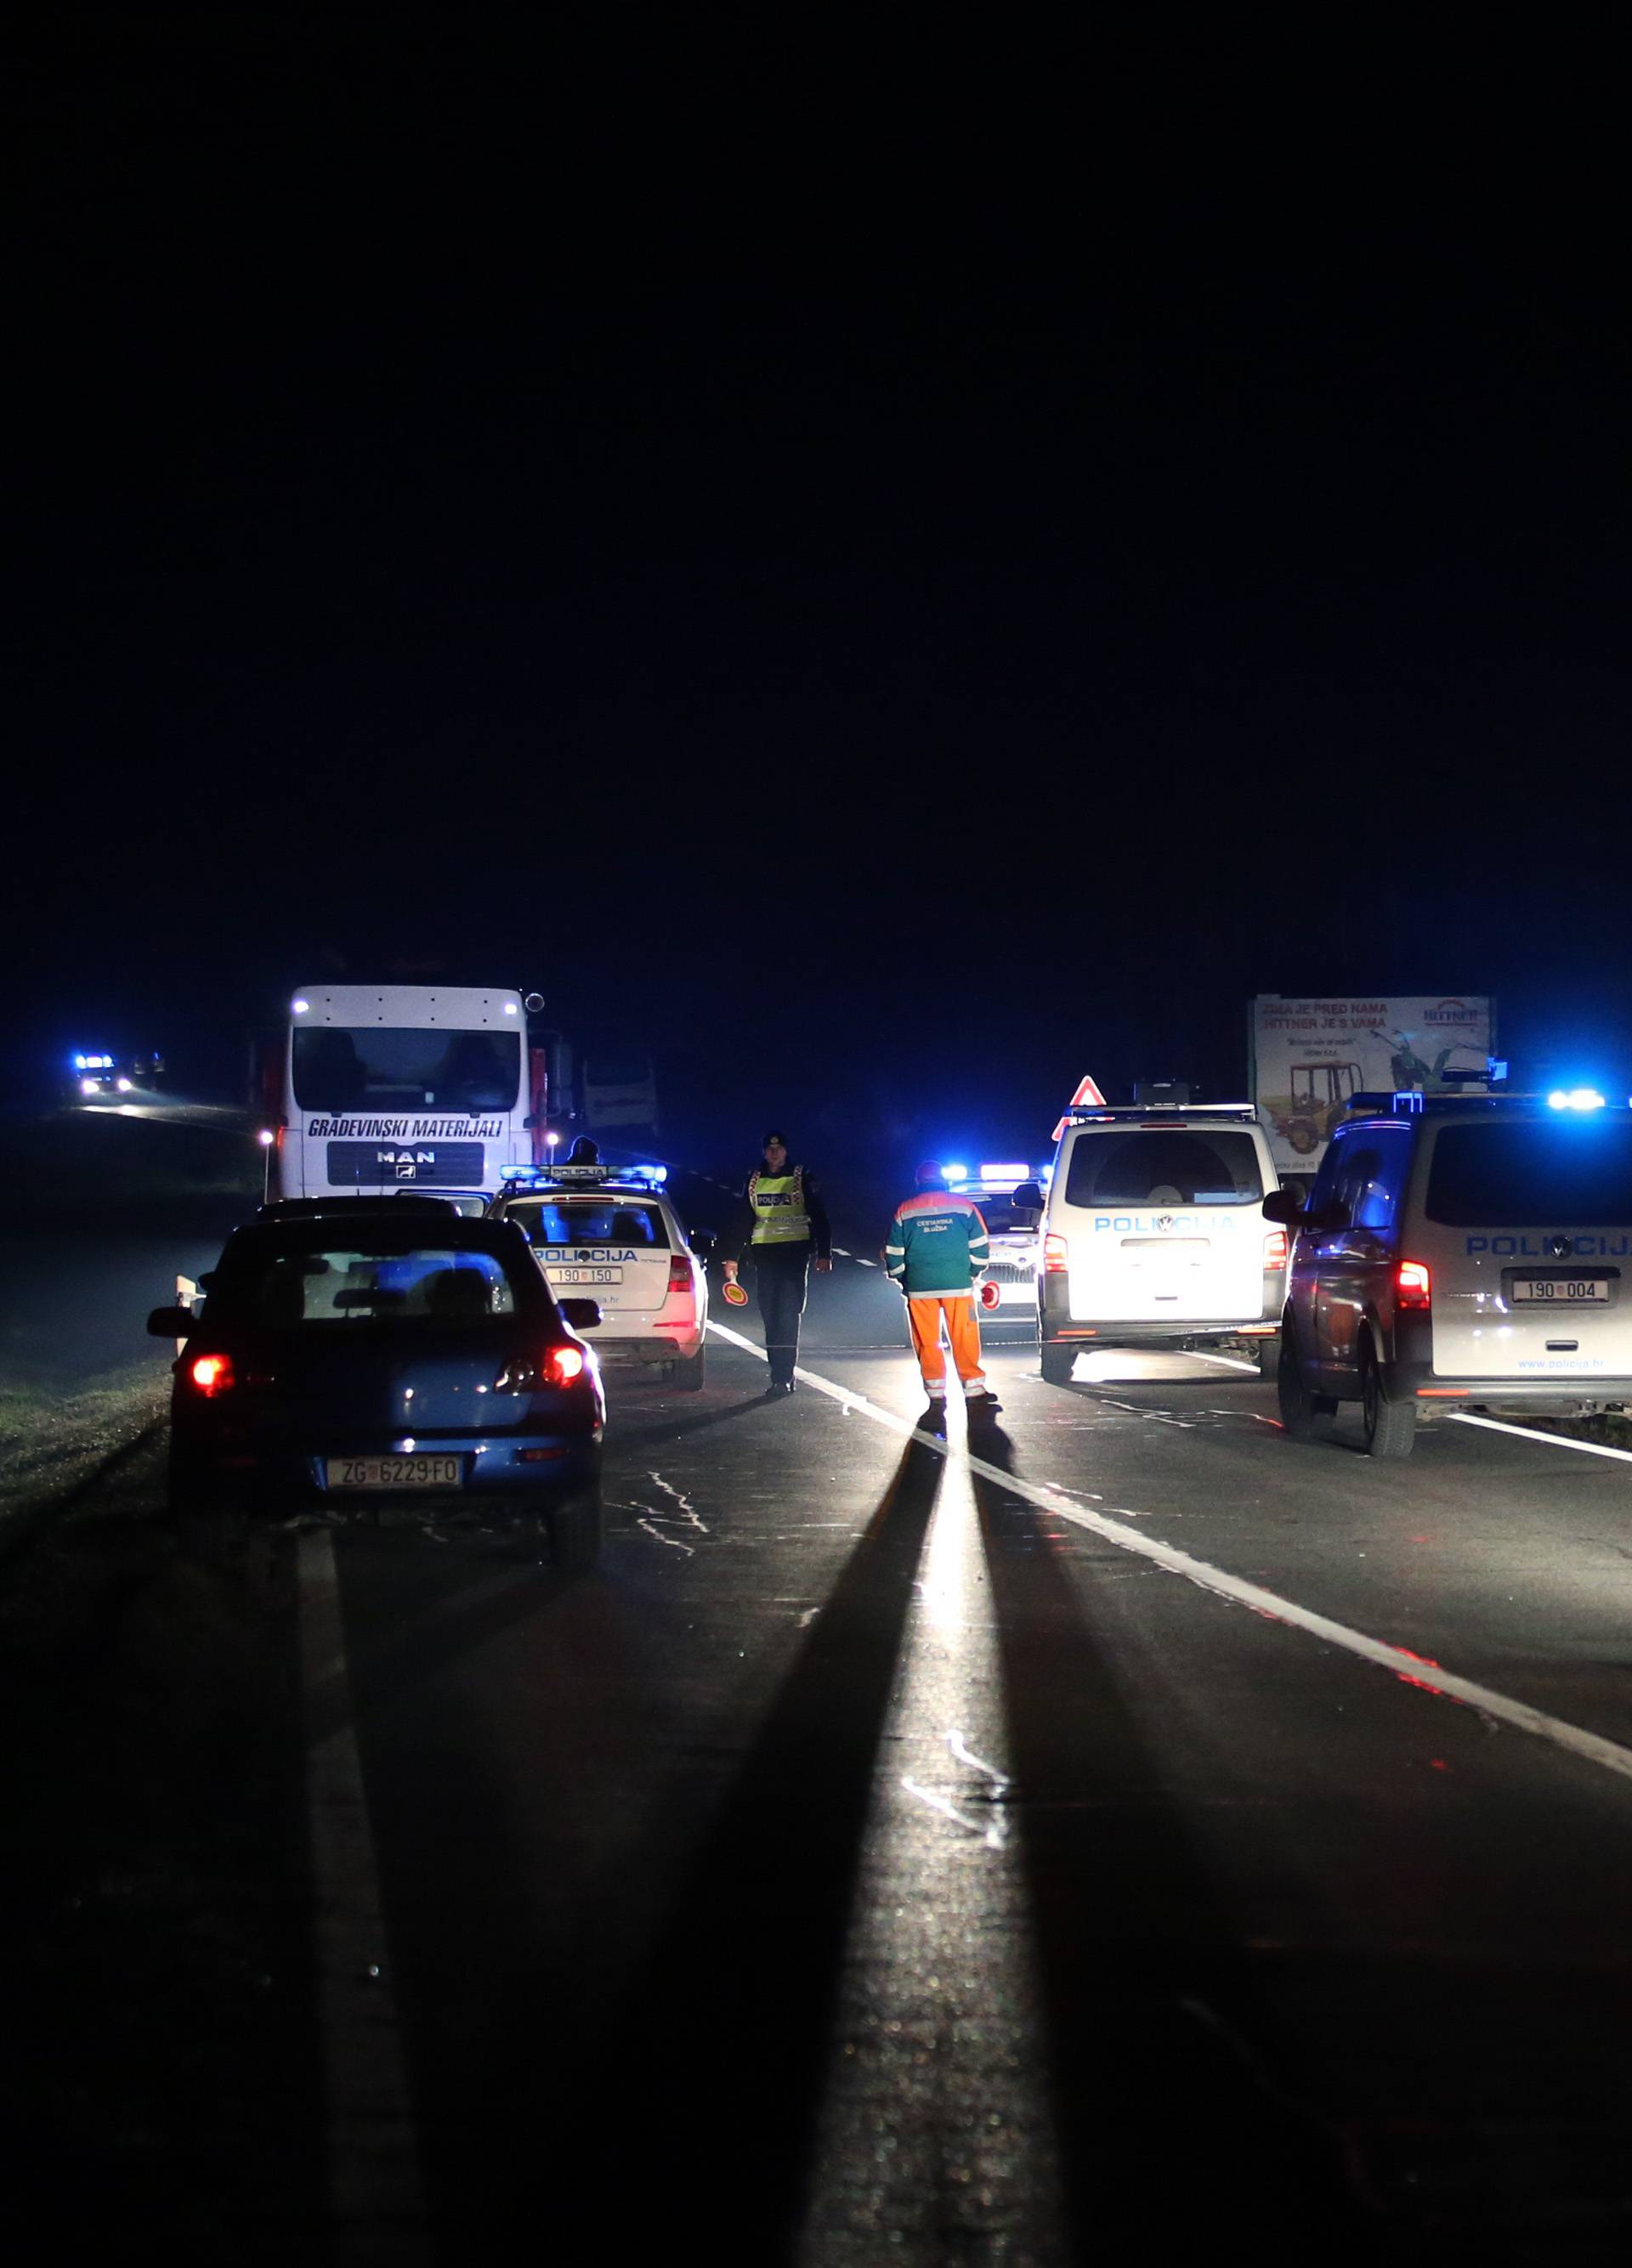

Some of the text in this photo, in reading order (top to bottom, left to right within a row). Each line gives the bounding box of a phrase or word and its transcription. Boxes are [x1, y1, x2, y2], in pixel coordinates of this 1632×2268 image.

[1295, 1004, 1309, 1014] JE
[1314, 1004, 1346, 1014] PRED
[1352, 1004, 1387, 1014] NAMA
[1321, 1019, 1336, 1028] JE
[411, 1120, 502, 1137] MATERIJALI
[377, 1151, 435, 1163] MAN
[1467, 1236, 1632, 1256] POLICIJ
[558, 1270, 611, 1281] 190 150
[1529, 1283, 1595, 1297] 190 004
[343, 1462, 366, 1483] ZG
